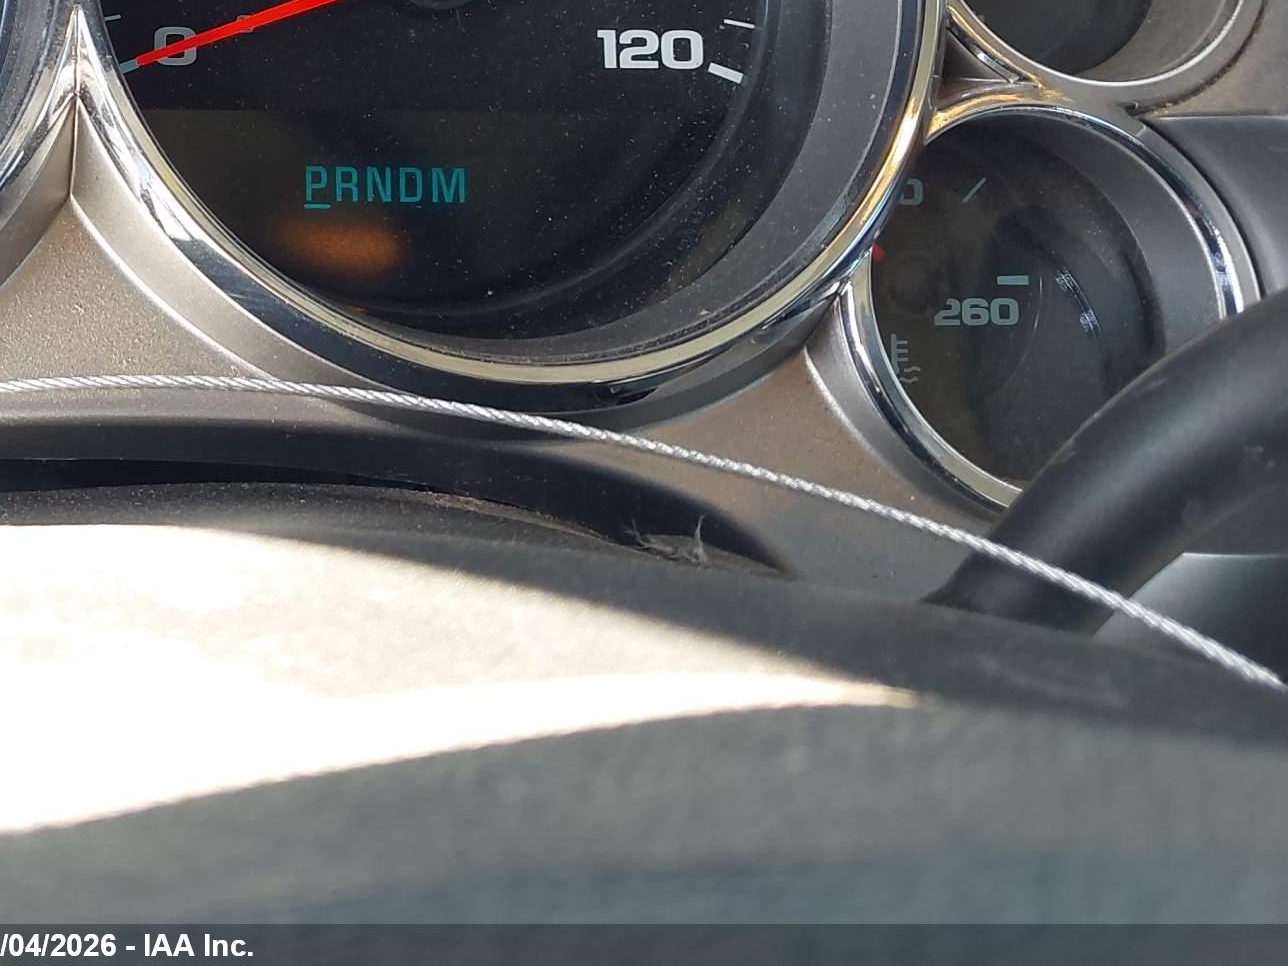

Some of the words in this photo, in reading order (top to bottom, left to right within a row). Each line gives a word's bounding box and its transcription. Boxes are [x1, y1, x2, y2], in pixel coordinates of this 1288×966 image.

[154, 26, 197, 66] 0
[597, 30, 703, 69] 120
[304, 165, 466, 203] PRNDM
[934, 298, 1019, 326] 260
